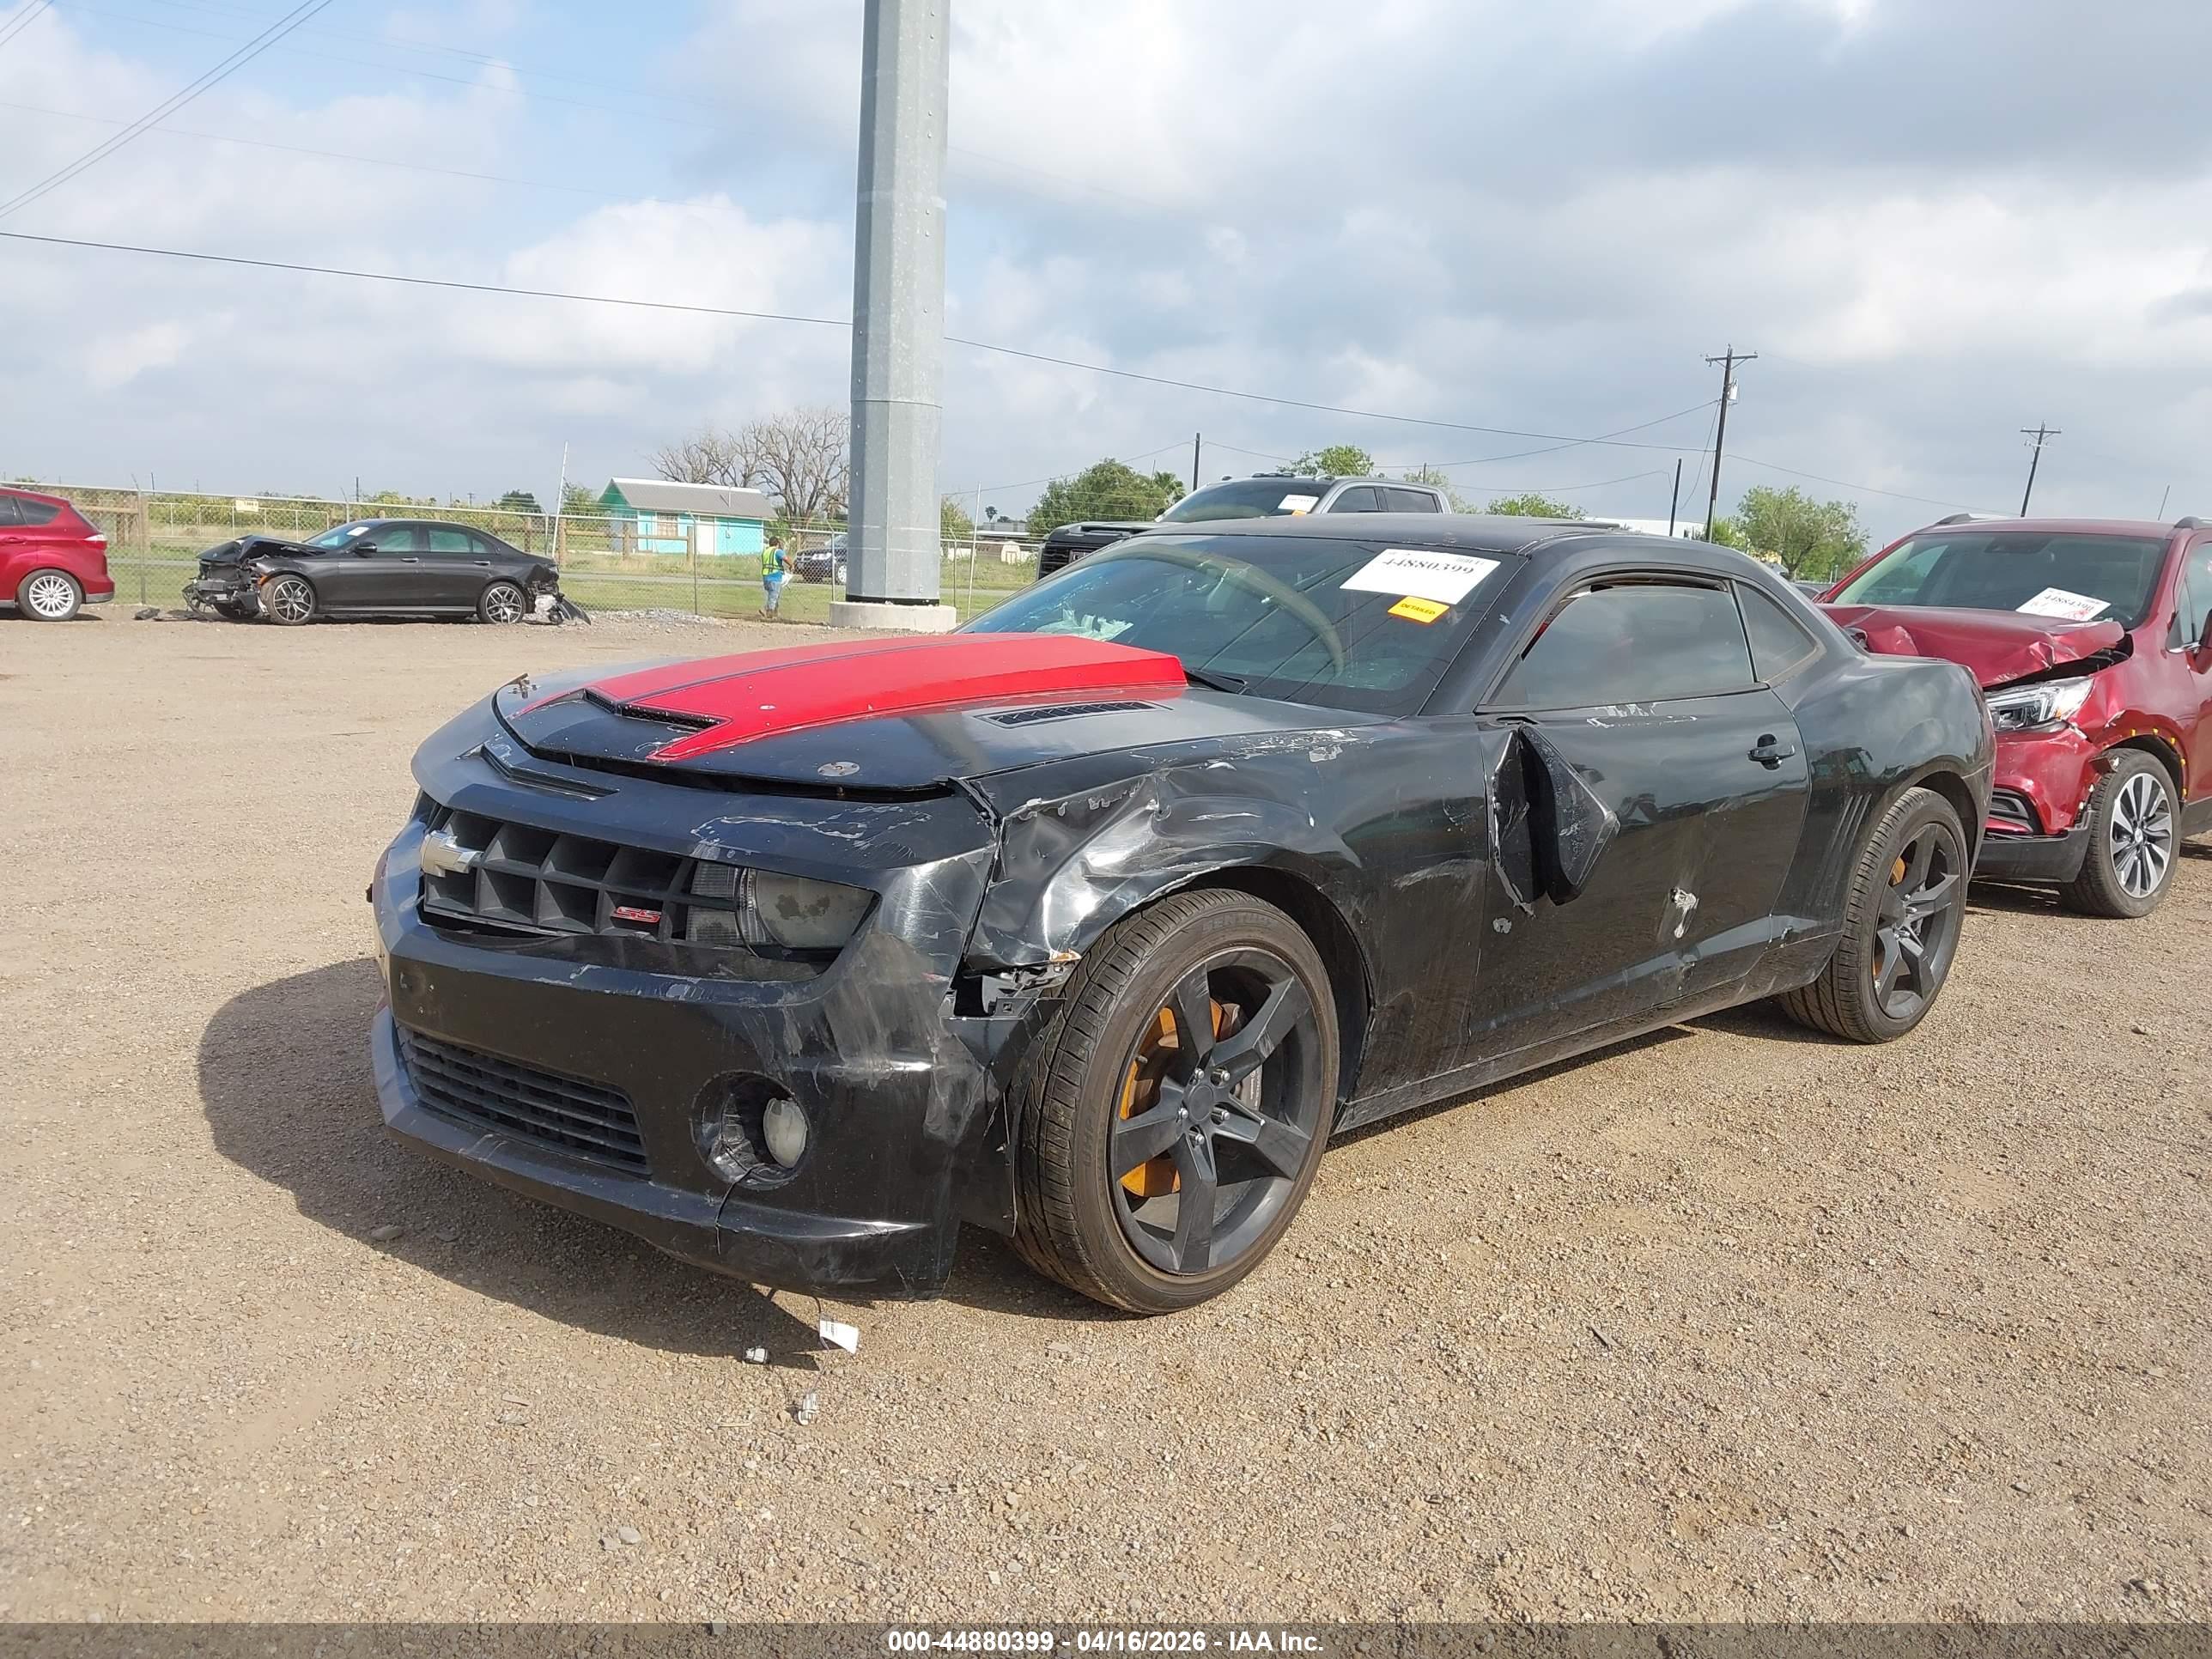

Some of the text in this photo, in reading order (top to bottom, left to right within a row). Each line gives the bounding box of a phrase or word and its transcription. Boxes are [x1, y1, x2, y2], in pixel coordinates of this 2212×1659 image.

[1382, 557, 1474, 574] 44880399
[1401, 603, 1436, 615] DETAILED
[611, 906, 662, 923] SS
